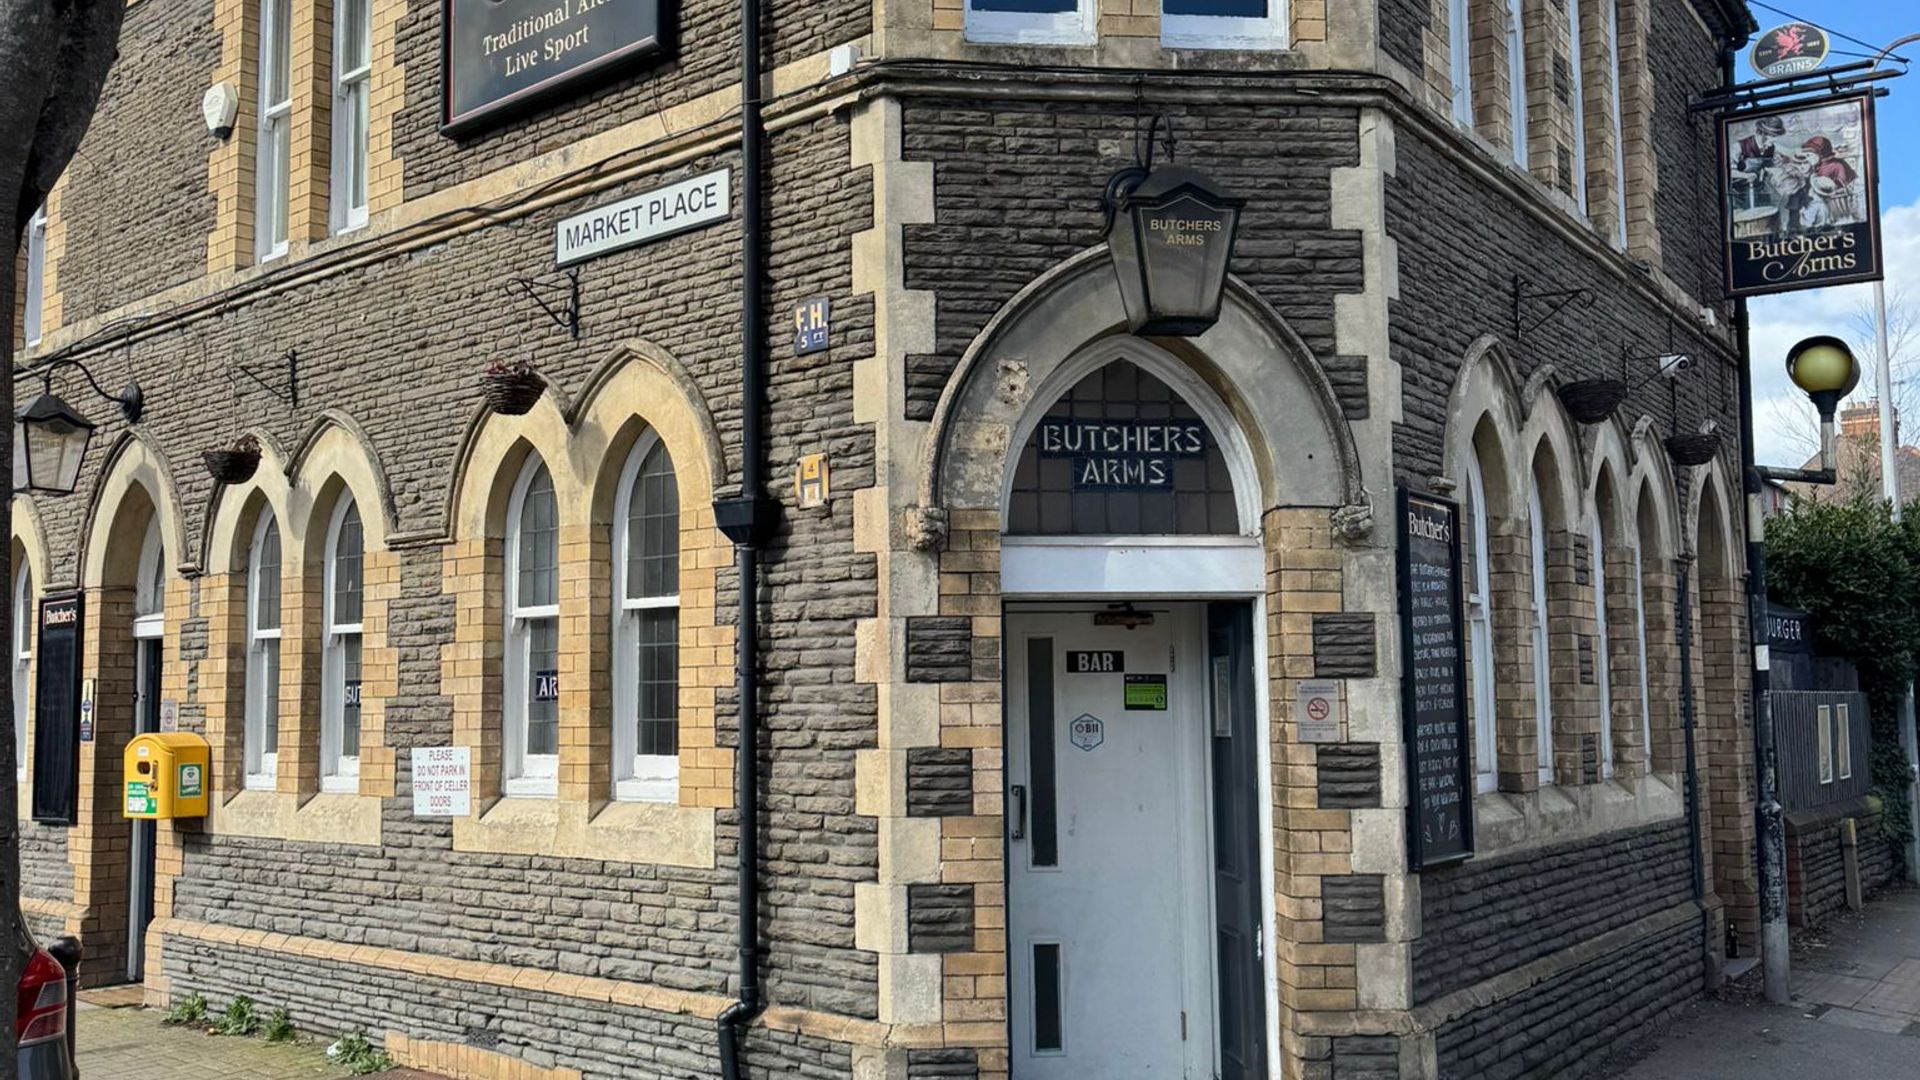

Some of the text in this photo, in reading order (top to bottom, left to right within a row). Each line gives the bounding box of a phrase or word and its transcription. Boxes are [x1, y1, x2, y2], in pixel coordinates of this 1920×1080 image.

[483, 0, 570, 56] Traditional
[505, 24, 590, 77] Live Sport
[1768, 60, 1813, 75] BRAINS
[566, 182, 717, 250] MARKET PLACE
[1150, 218, 1222, 231] BUTCHERS
[1166, 233, 1205, 246] ARMS
[1748, 230, 1856, 261] Butcher's
[1762, 250, 1857, 281] Arms
[1043, 425, 1201, 452] BUTCHERS
[1081, 459, 1167, 485] ARMS
[1408, 511, 1450, 542] Butcher's
[46, 607, 77, 625] Butcher's
[1077, 652, 1114, 671] BAR
[429, 749, 453, 761] PLEASE
[417, 764, 465, 776] DO NOT PARK IN
[414, 780, 434, 791] FRONT
[435, 780, 443, 791] OF
[430, 795, 451, 807] DOORS
